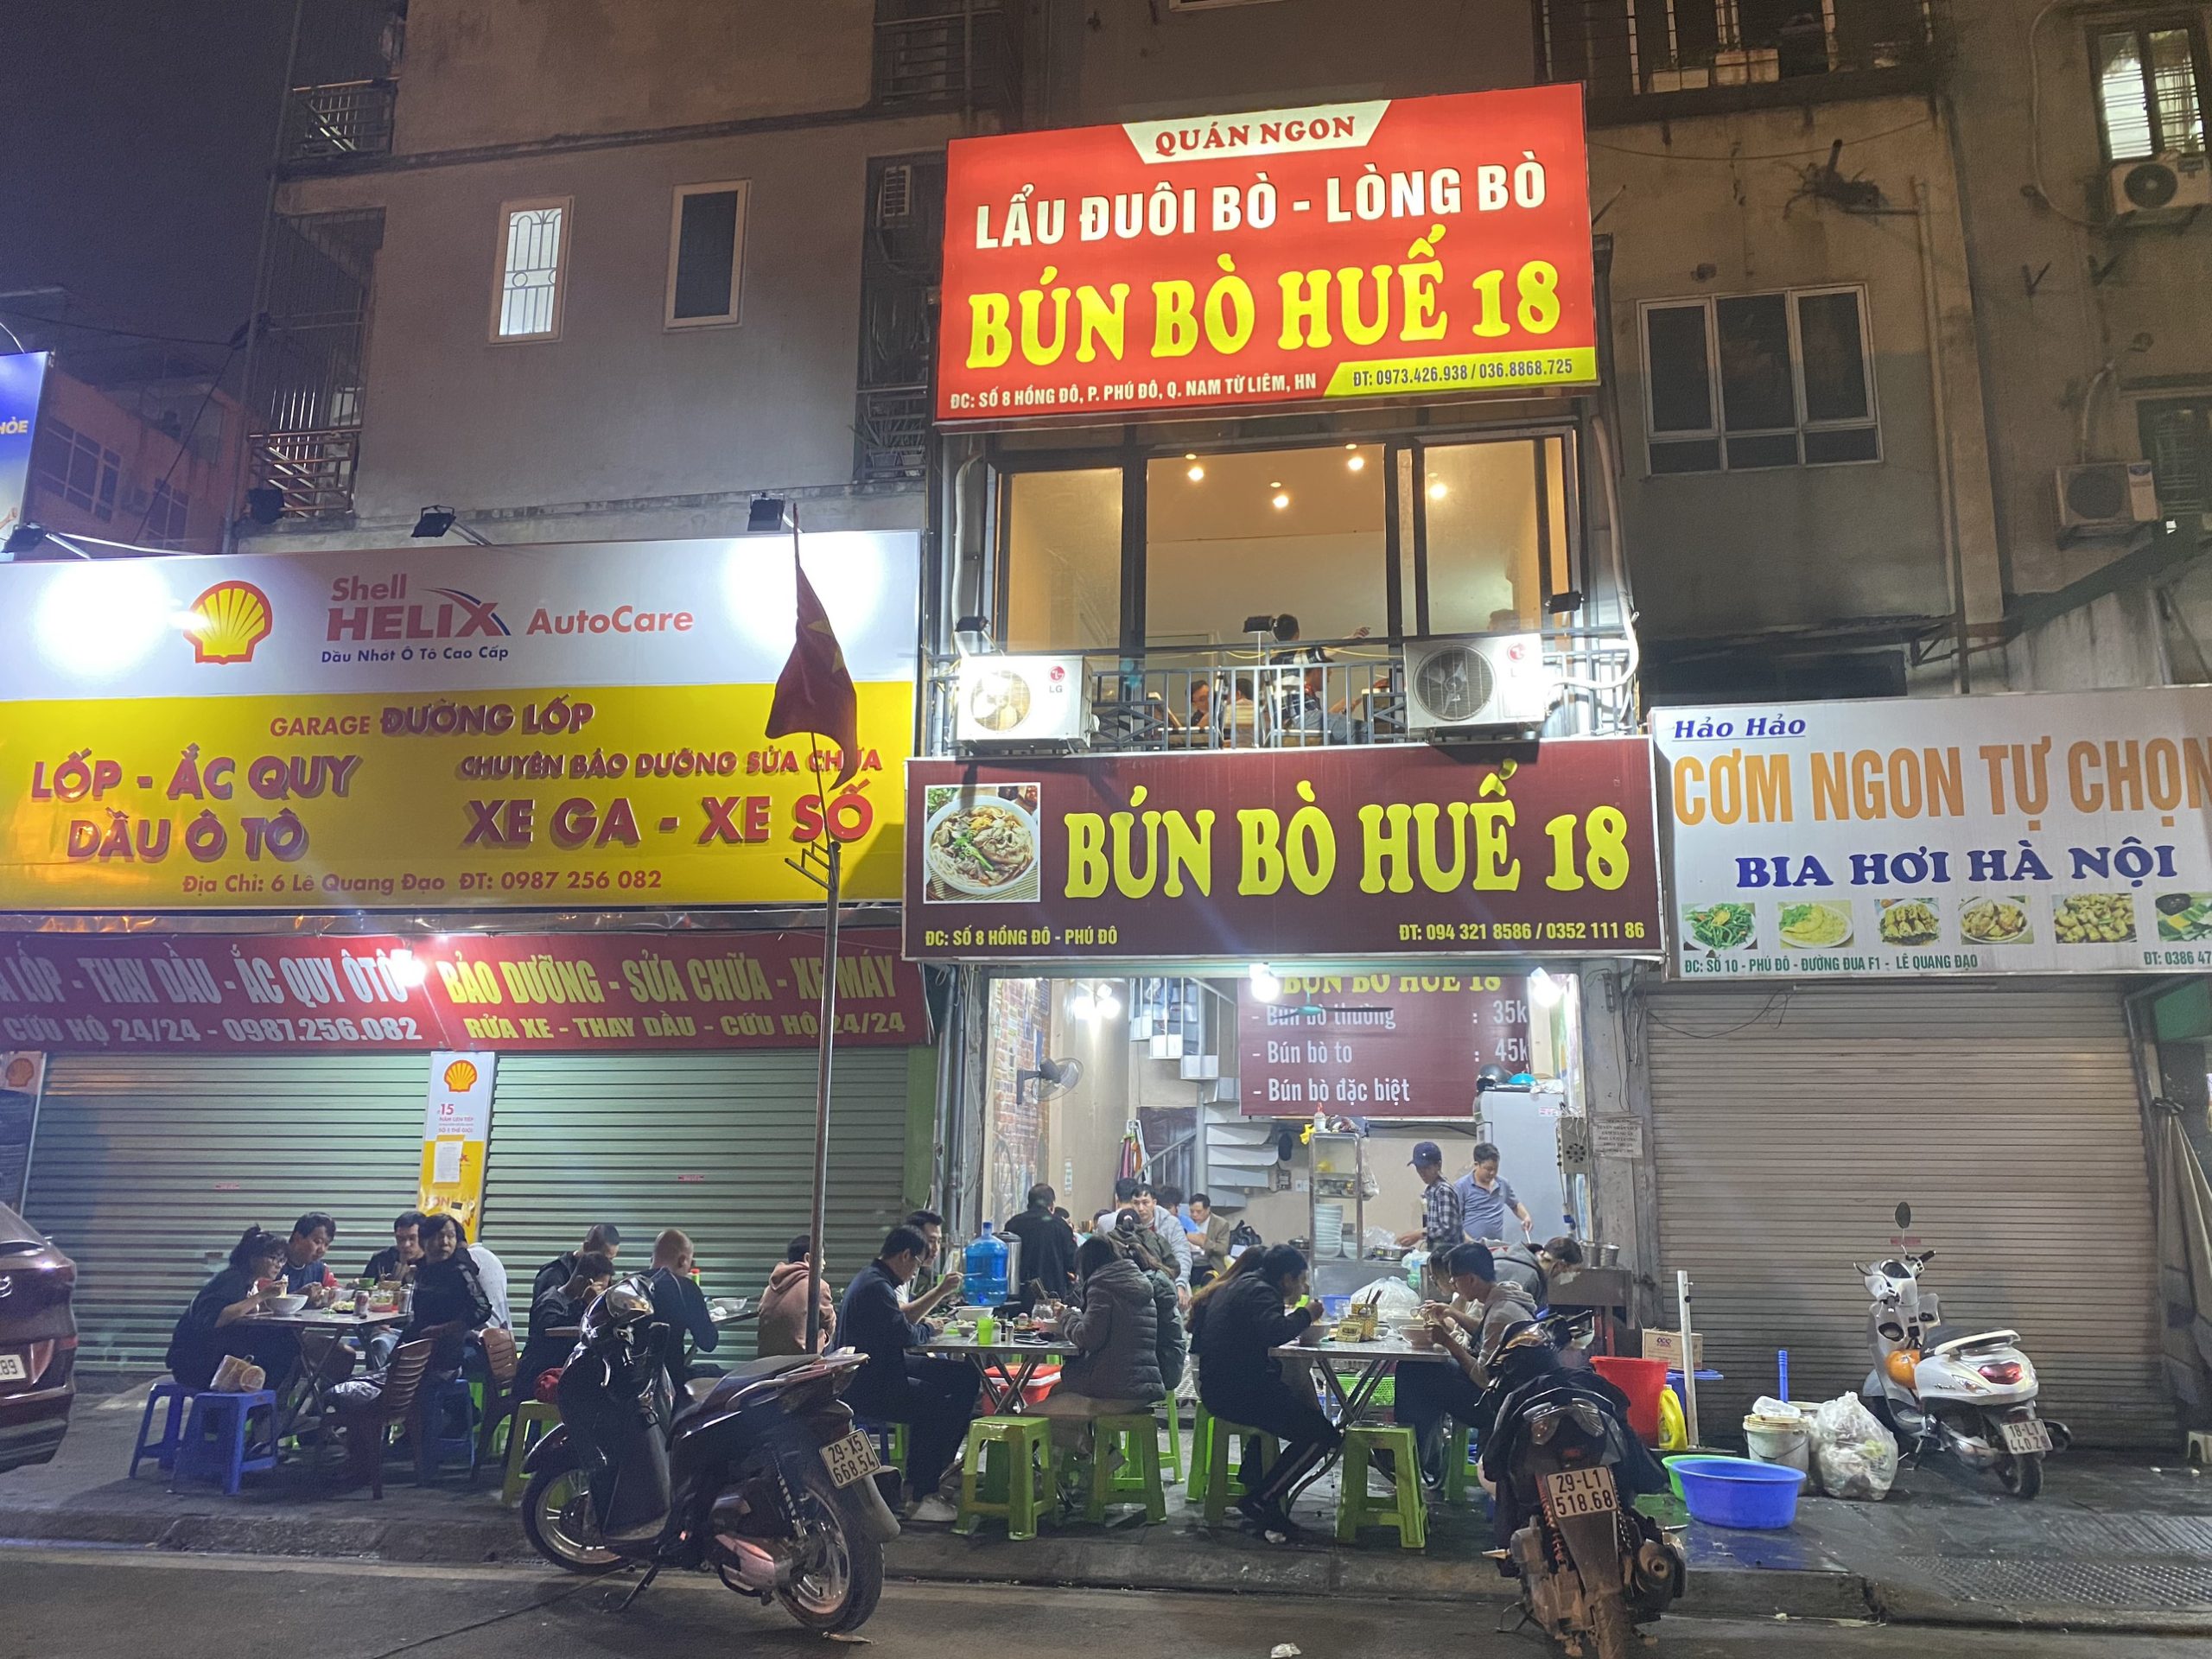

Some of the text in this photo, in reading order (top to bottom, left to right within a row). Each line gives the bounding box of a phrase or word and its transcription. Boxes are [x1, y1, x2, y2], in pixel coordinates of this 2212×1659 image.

[1155, 115, 1356, 156] QUÁN NGON
[976, 150, 1548, 250] LẨU ĐUÔI BÒ LÒNG BÒ
[966, 223, 1561, 370] BÚN BÒ HUẾ 18
[1353, 359, 1573, 387] ĐT: 0973.426.938 036.8868.725
[950, 372, 1317, 410] ĐC: SỐ 8 HỒNG ĐÔ, P. PHÚ ĐÔ, Q. NAM TỪ LIÊM, HN
[331, 574, 407, 601] Shell
[327, 593, 505, 641] HELIX
[525, 605, 694, 636] AutoCare
[321, 650, 351, 663] Dầu
[401, 646, 413, 660] Ô
[420, 648, 437, 659] Tô
[443, 647, 472, 659] Cao
[479, 645, 509, 661] Cấp
[270, 694, 594, 737] GARAGE ĐƯỜNG LỐP
[1675, 714, 1806, 738] Hảo Hảo
[31, 742, 360, 801] LỐP ẮC QUY
[458, 750, 564, 779] CHUYÊN
[569, 747, 628, 779] BẢO
[635, 747, 737, 778] DƯỠNG
[746, 745, 799, 775] SỬA
[1674, 736, 2212, 831] CƠM NGON TỰ CHỌN
[465, 779, 874, 847] XE GA XE SỐ
[1065, 758, 1630, 899] BÚN BÒ HUẾ 18
[67, 807, 308, 862] DẦU Ô TÔ
[1735, 836, 2178, 888] BIA HƠI HÀ NỘI
[182, 870, 662, 896] Địa Chỉ: 6 Lê Quang Đạo ĐT: 0987 256 082
[925, 925, 1118, 946] ĐC: SỐ 8 HỒNG ĐÔ PHÚ ĐÔ
[1399, 922, 1645, 940] ĐT: 094 321 8586 0352 111 86
[1685, 953, 1979, 973] ĐC: SỐ 10 PHÚ ĐÔ ĐƯỜNG ĐUA F1 LÊ QUANG ĐẠO
[2144, 951, 2162, 965] ĐT:
[2164, 950, 2195, 965] 0386
[5, 941, 66, 1002] LỐP
[77, 957, 160, 1002] THAY
[150, 942, 222, 1004] DẦU
[230, 944, 284, 1004] ẮC
[279, 957, 346, 1008] QUY
[435, 950, 502, 1004] BẢO
[499, 954, 606, 1003] DƯỠNG
[621, 949, 689, 1002] SỬA
[687, 952, 773, 1001] CHỮA
[836, 949, 896, 998] MÁY
[463, 1013, 519, 1039] RỬA
[518, 1018, 554, 1039] XE
[572, 1017, 635, 1038] THAY
[642, 1009, 696, 1037] DẦU
[720, 1012, 775, 1036] CỨU
[780, 1011, 819, 1038] HỘ
[1492, 1000, 1528, 1024] 35k
[3, 1014, 423, 1046] CỨU HỘ 24/24 0987.256.082
[1268, 1038, 1529, 1064] Bún bò to 45k
[1268, 1078, 1410, 1106] Bún bò đặc biệt
[441, 1103, 454, 1115] 15
[2009, 1422, 2039, 1437] 18-L1
[828, 1434, 863, 1465] 29-X5
[833, 1452, 875, 1484] 668.54
[1556, 1469, 1602, 1494] 29-L1
[1556, 1490, 1613, 1516] 518.68
